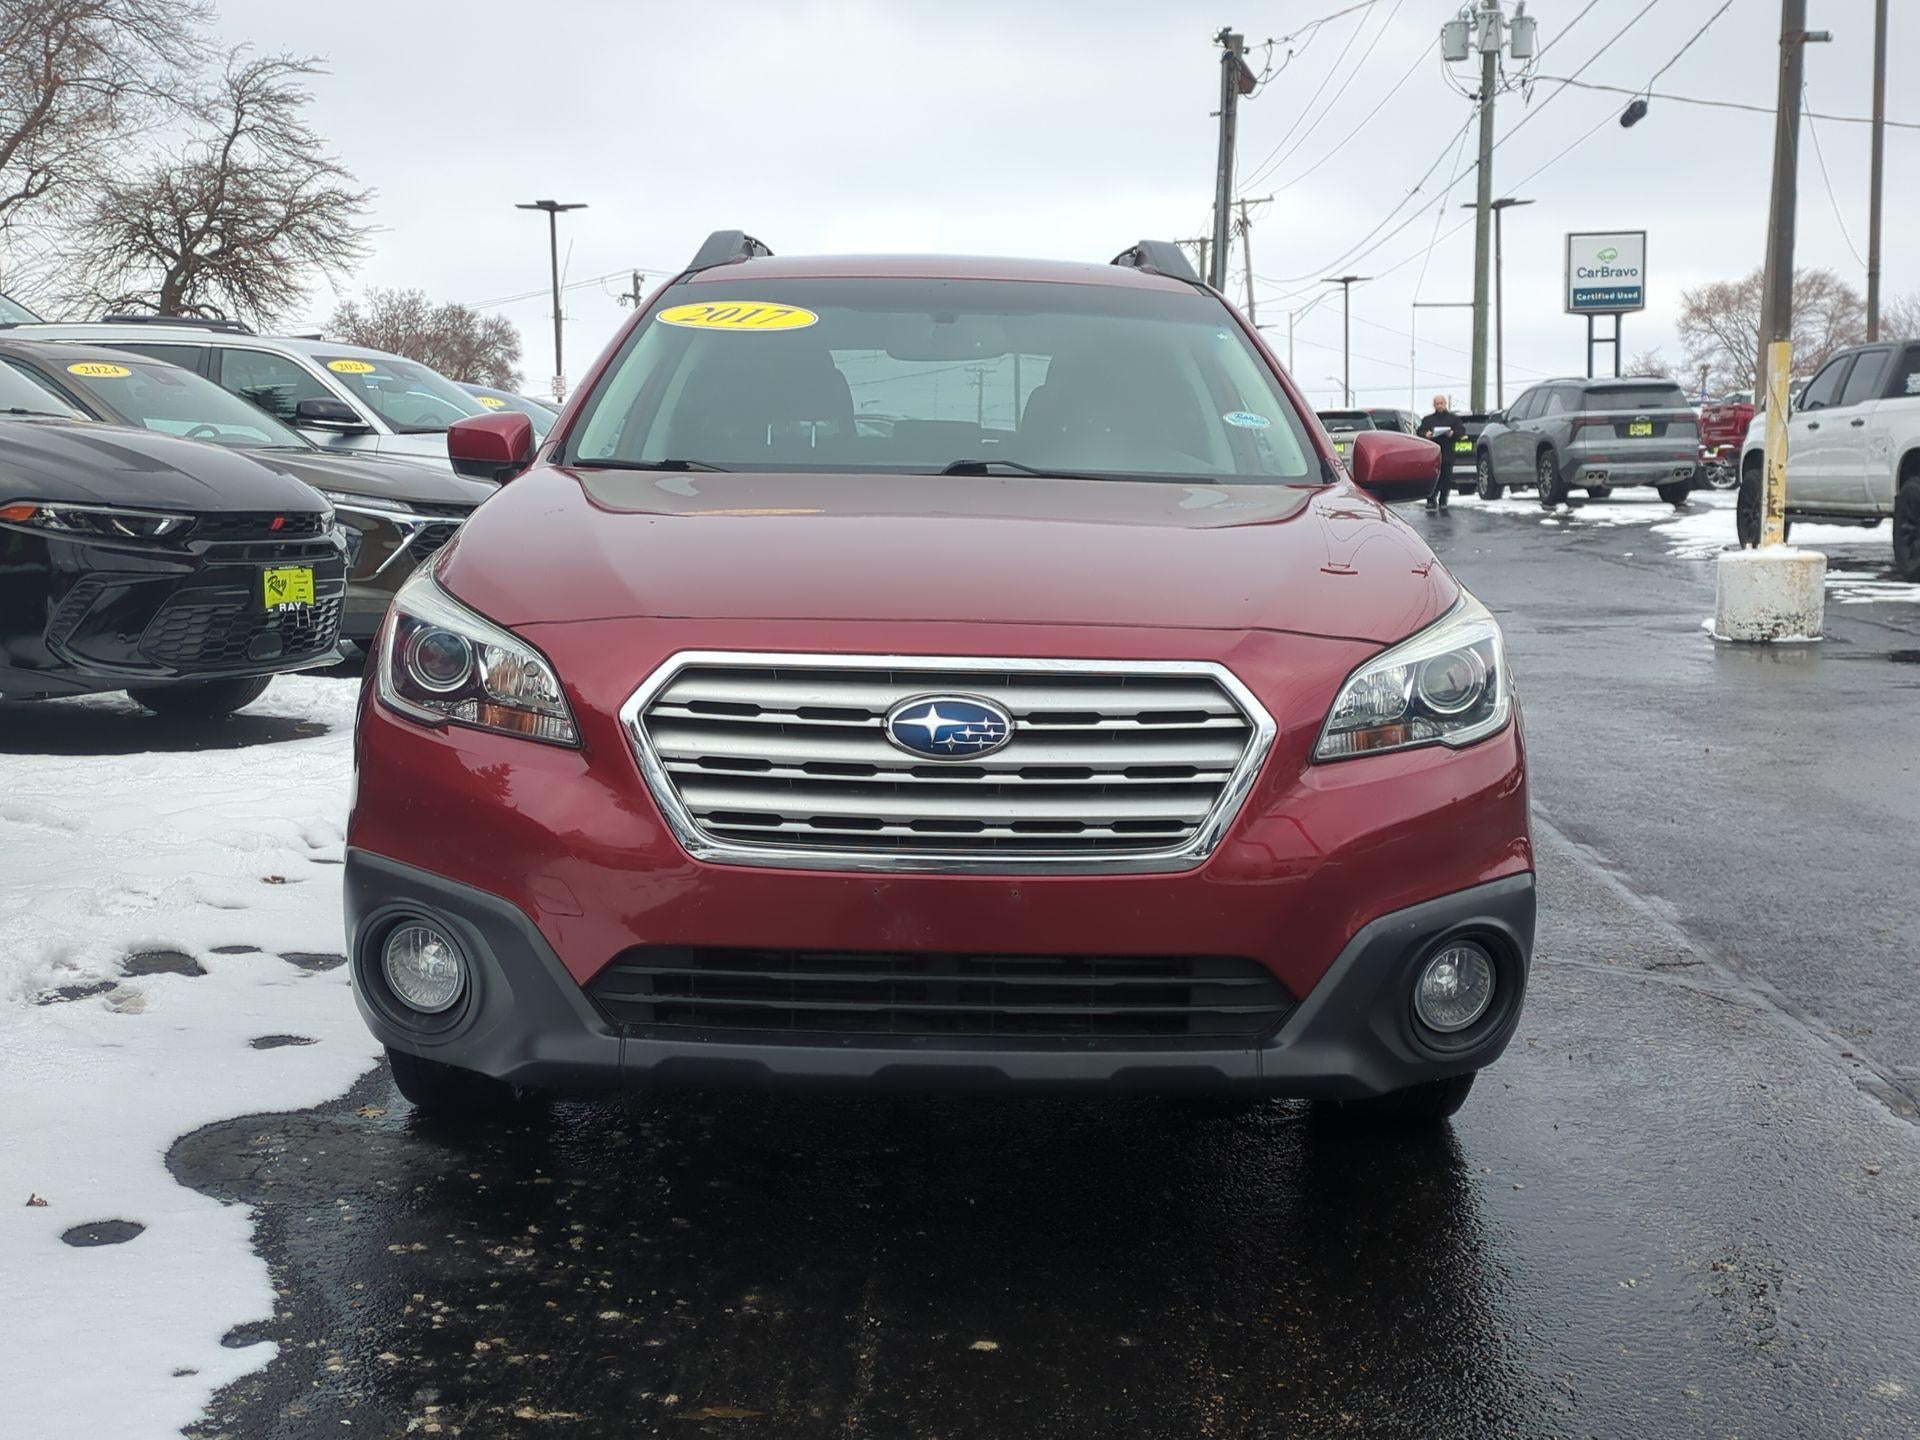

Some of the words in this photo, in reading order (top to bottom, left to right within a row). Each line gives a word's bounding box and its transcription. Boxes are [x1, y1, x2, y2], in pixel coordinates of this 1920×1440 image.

[1577, 266, 1638, 278] CarBravo
[1576, 292, 1615, 301] Certified
[1617, 291, 1638, 299] Used
[676, 306, 796, 325] 2017
[80, 365, 119, 374] 2024
[268, 575, 287, 597] Ray
[279, 602, 302, 612] RAY
